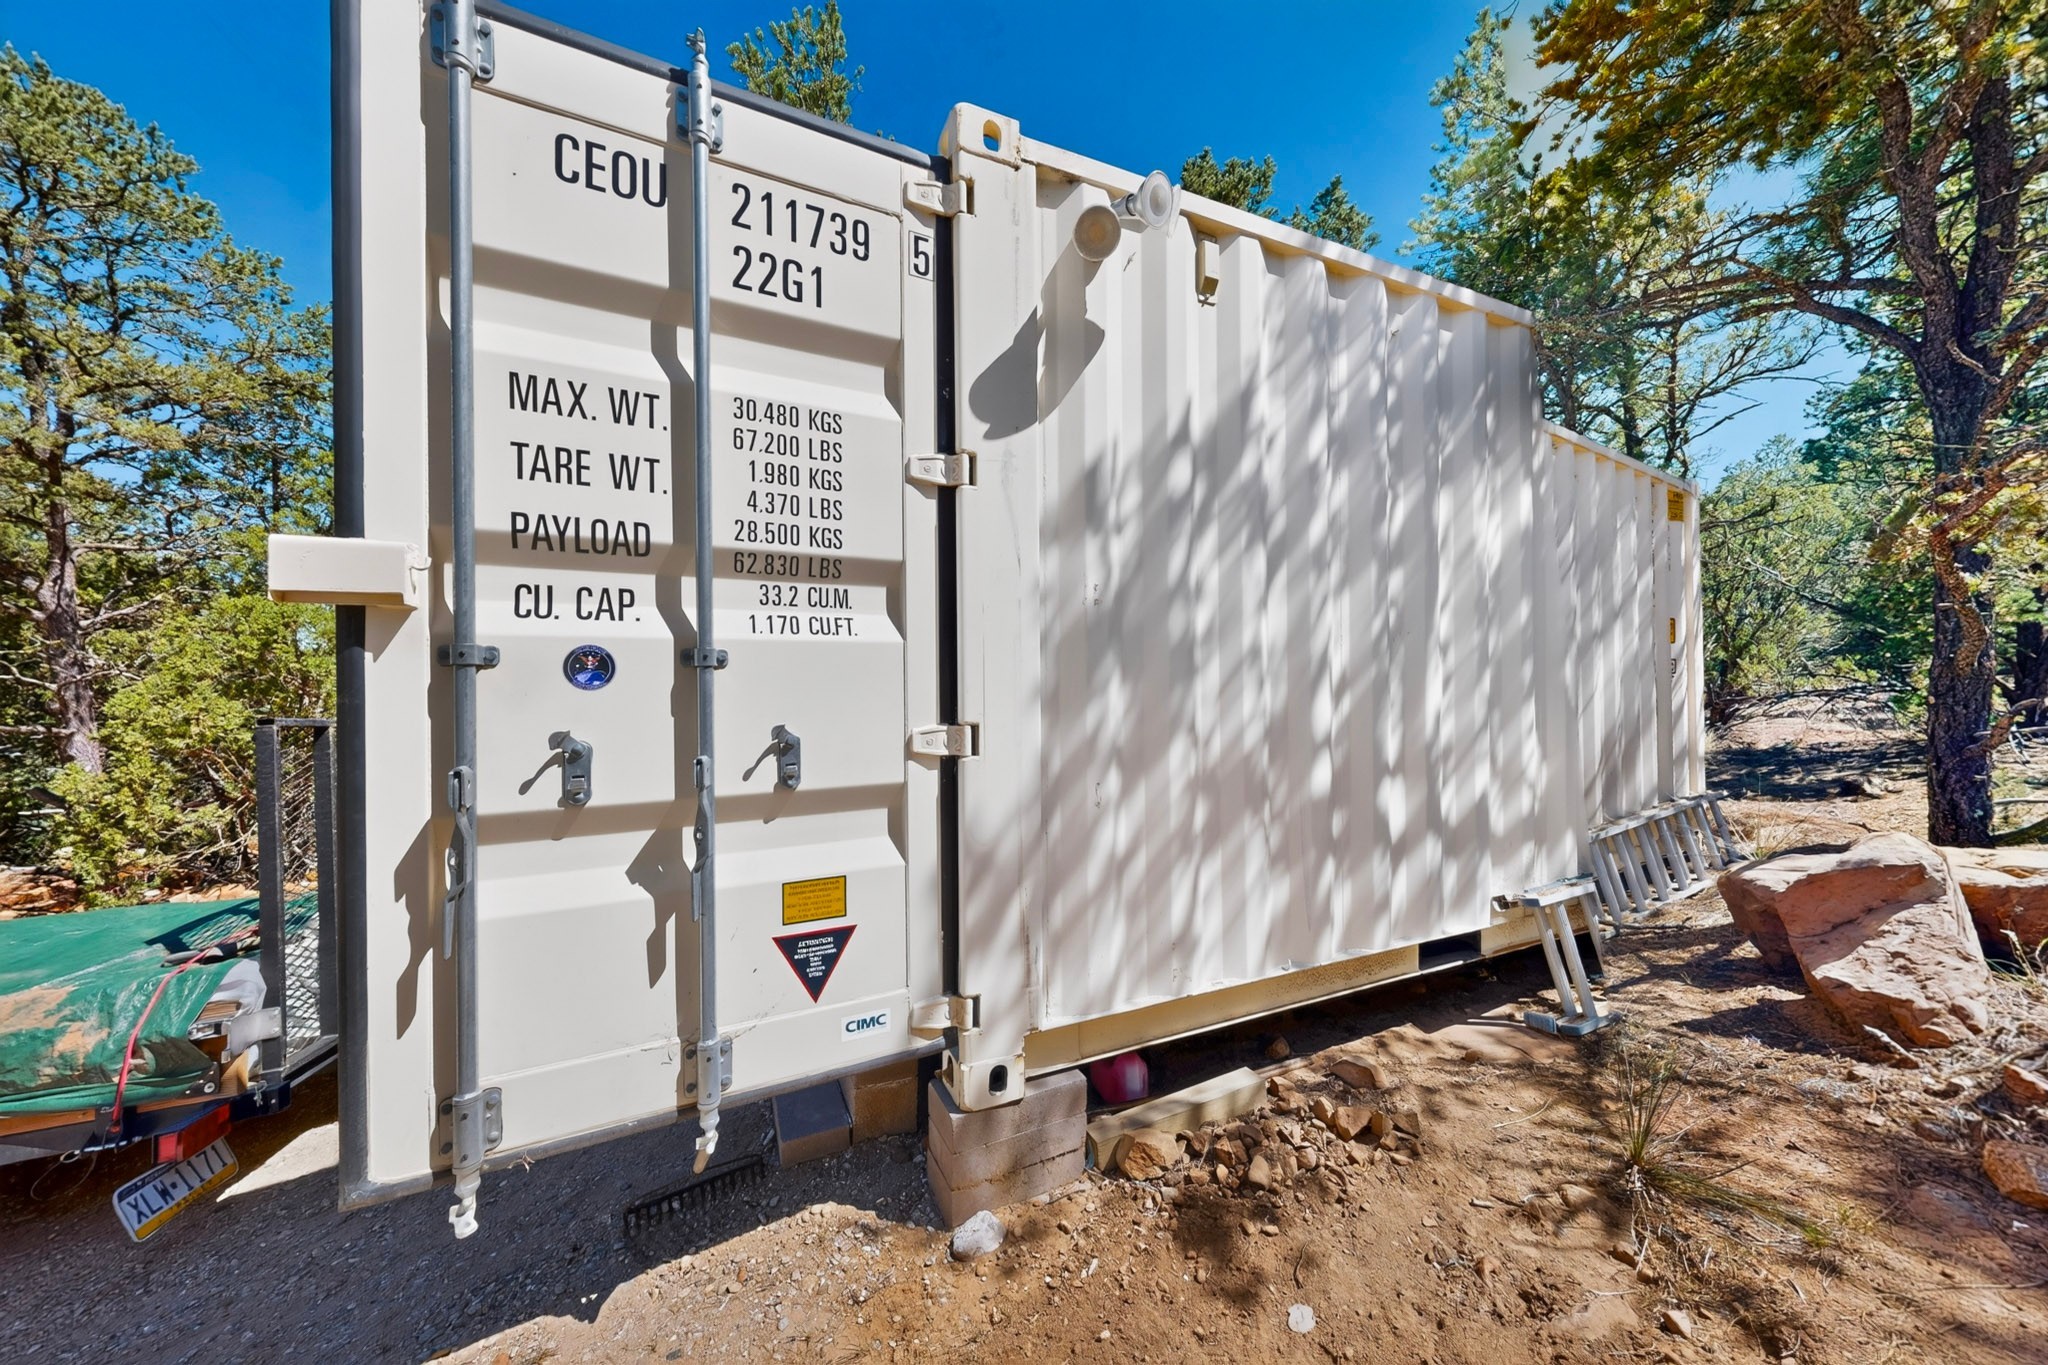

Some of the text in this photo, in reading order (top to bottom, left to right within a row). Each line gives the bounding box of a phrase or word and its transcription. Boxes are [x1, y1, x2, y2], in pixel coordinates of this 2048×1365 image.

[554, 133, 668, 208] CEOU
[731, 182, 870, 262] 211739
[913, 236, 930, 277] 5
[732, 245, 823, 308] 22G1
[508, 371, 668, 432] MAX. WT.
[808, 408, 843, 435] KGS
[808, 438, 843, 464] LBS
[510, 441, 668, 495] TARE WT.
[808, 468, 843, 492] KGS
[808, 497, 843, 521] LBS
[510, 511, 651, 557] PAYLOAD
[808, 526, 843, 550] KGS
[808, 557, 842, 579] LBS
[513, 583, 641, 622] CU. CAP.
[758, 583, 799, 608] 33.2
[845, 1013, 887, 1033] CIMC
